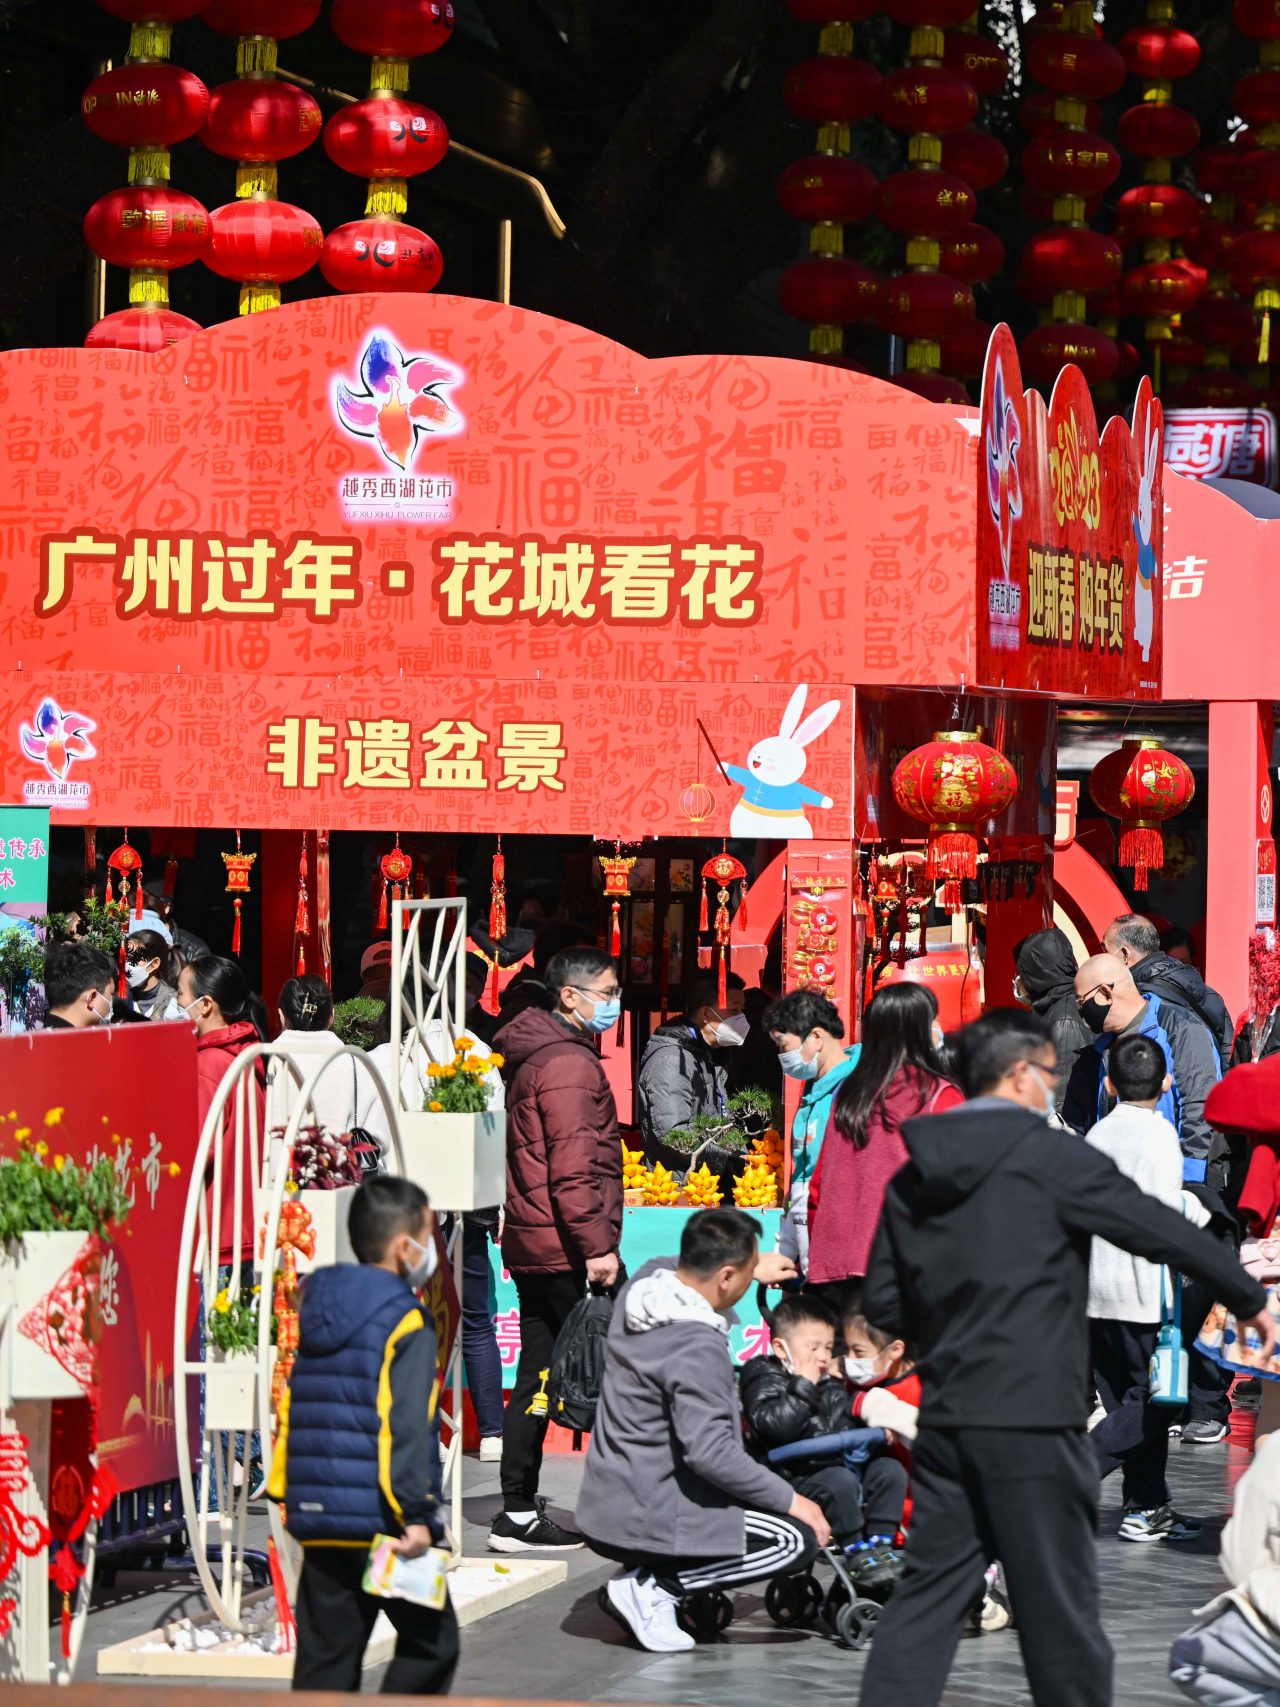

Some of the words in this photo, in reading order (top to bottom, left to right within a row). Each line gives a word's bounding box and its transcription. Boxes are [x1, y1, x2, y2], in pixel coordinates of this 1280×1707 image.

[342, 478, 452, 498] 越秀西湖花市
[343, 511, 373, 519] YUEXIU
[374, 511, 394, 519] XIHU
[397, 511, 432, 519] FLOWER
[433, 511, 452, 519] FAIR
[1027, 548, 1076, 641] 迎新春
[1079, 559, 1123, 649] 购年货
[267, 718, 566, 791] 非遗盆景
[26, 783, 89, 796] 越秀西湖花市
